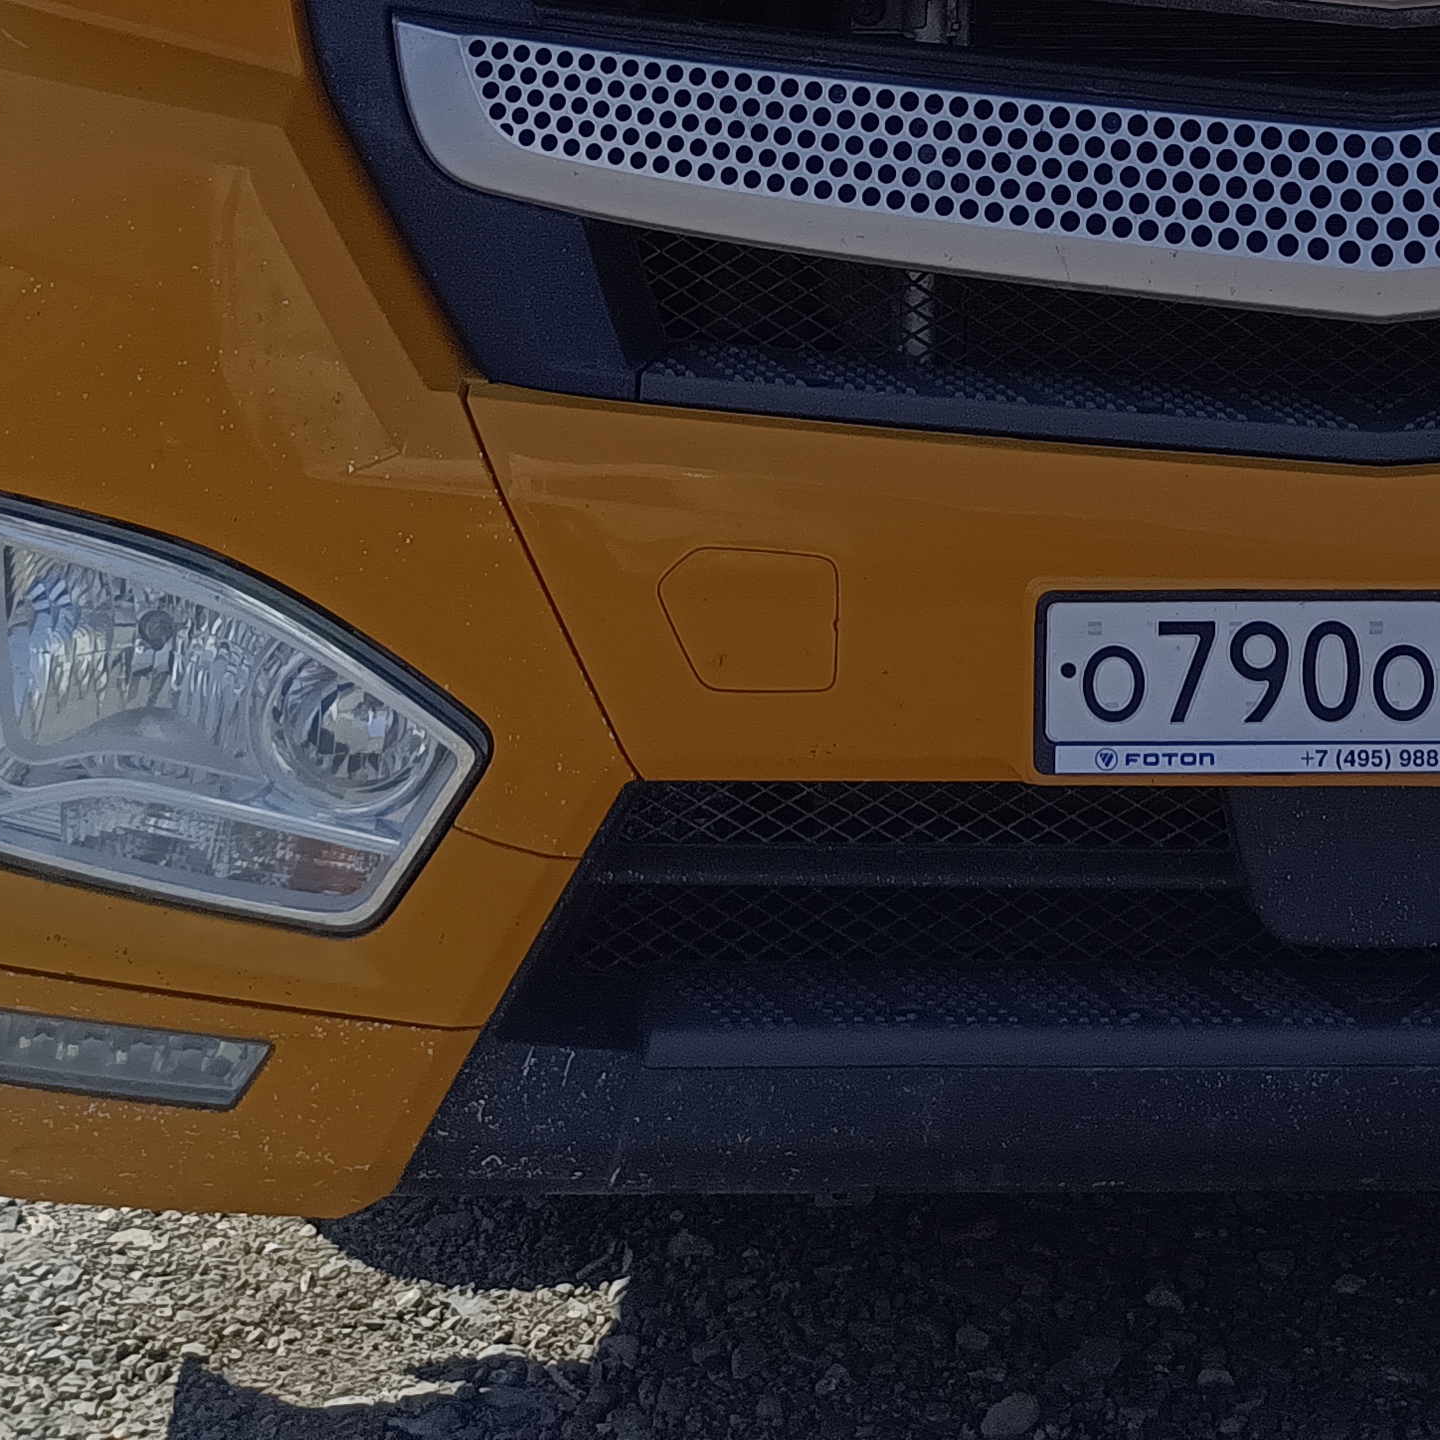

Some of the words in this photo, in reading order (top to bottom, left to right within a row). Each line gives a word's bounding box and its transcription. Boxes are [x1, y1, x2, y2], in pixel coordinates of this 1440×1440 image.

[1125, 752, 1215, 767] FOTON
[1300, 749, 1329, 768] +7
[1335, 748, 1392, 770] (495)
